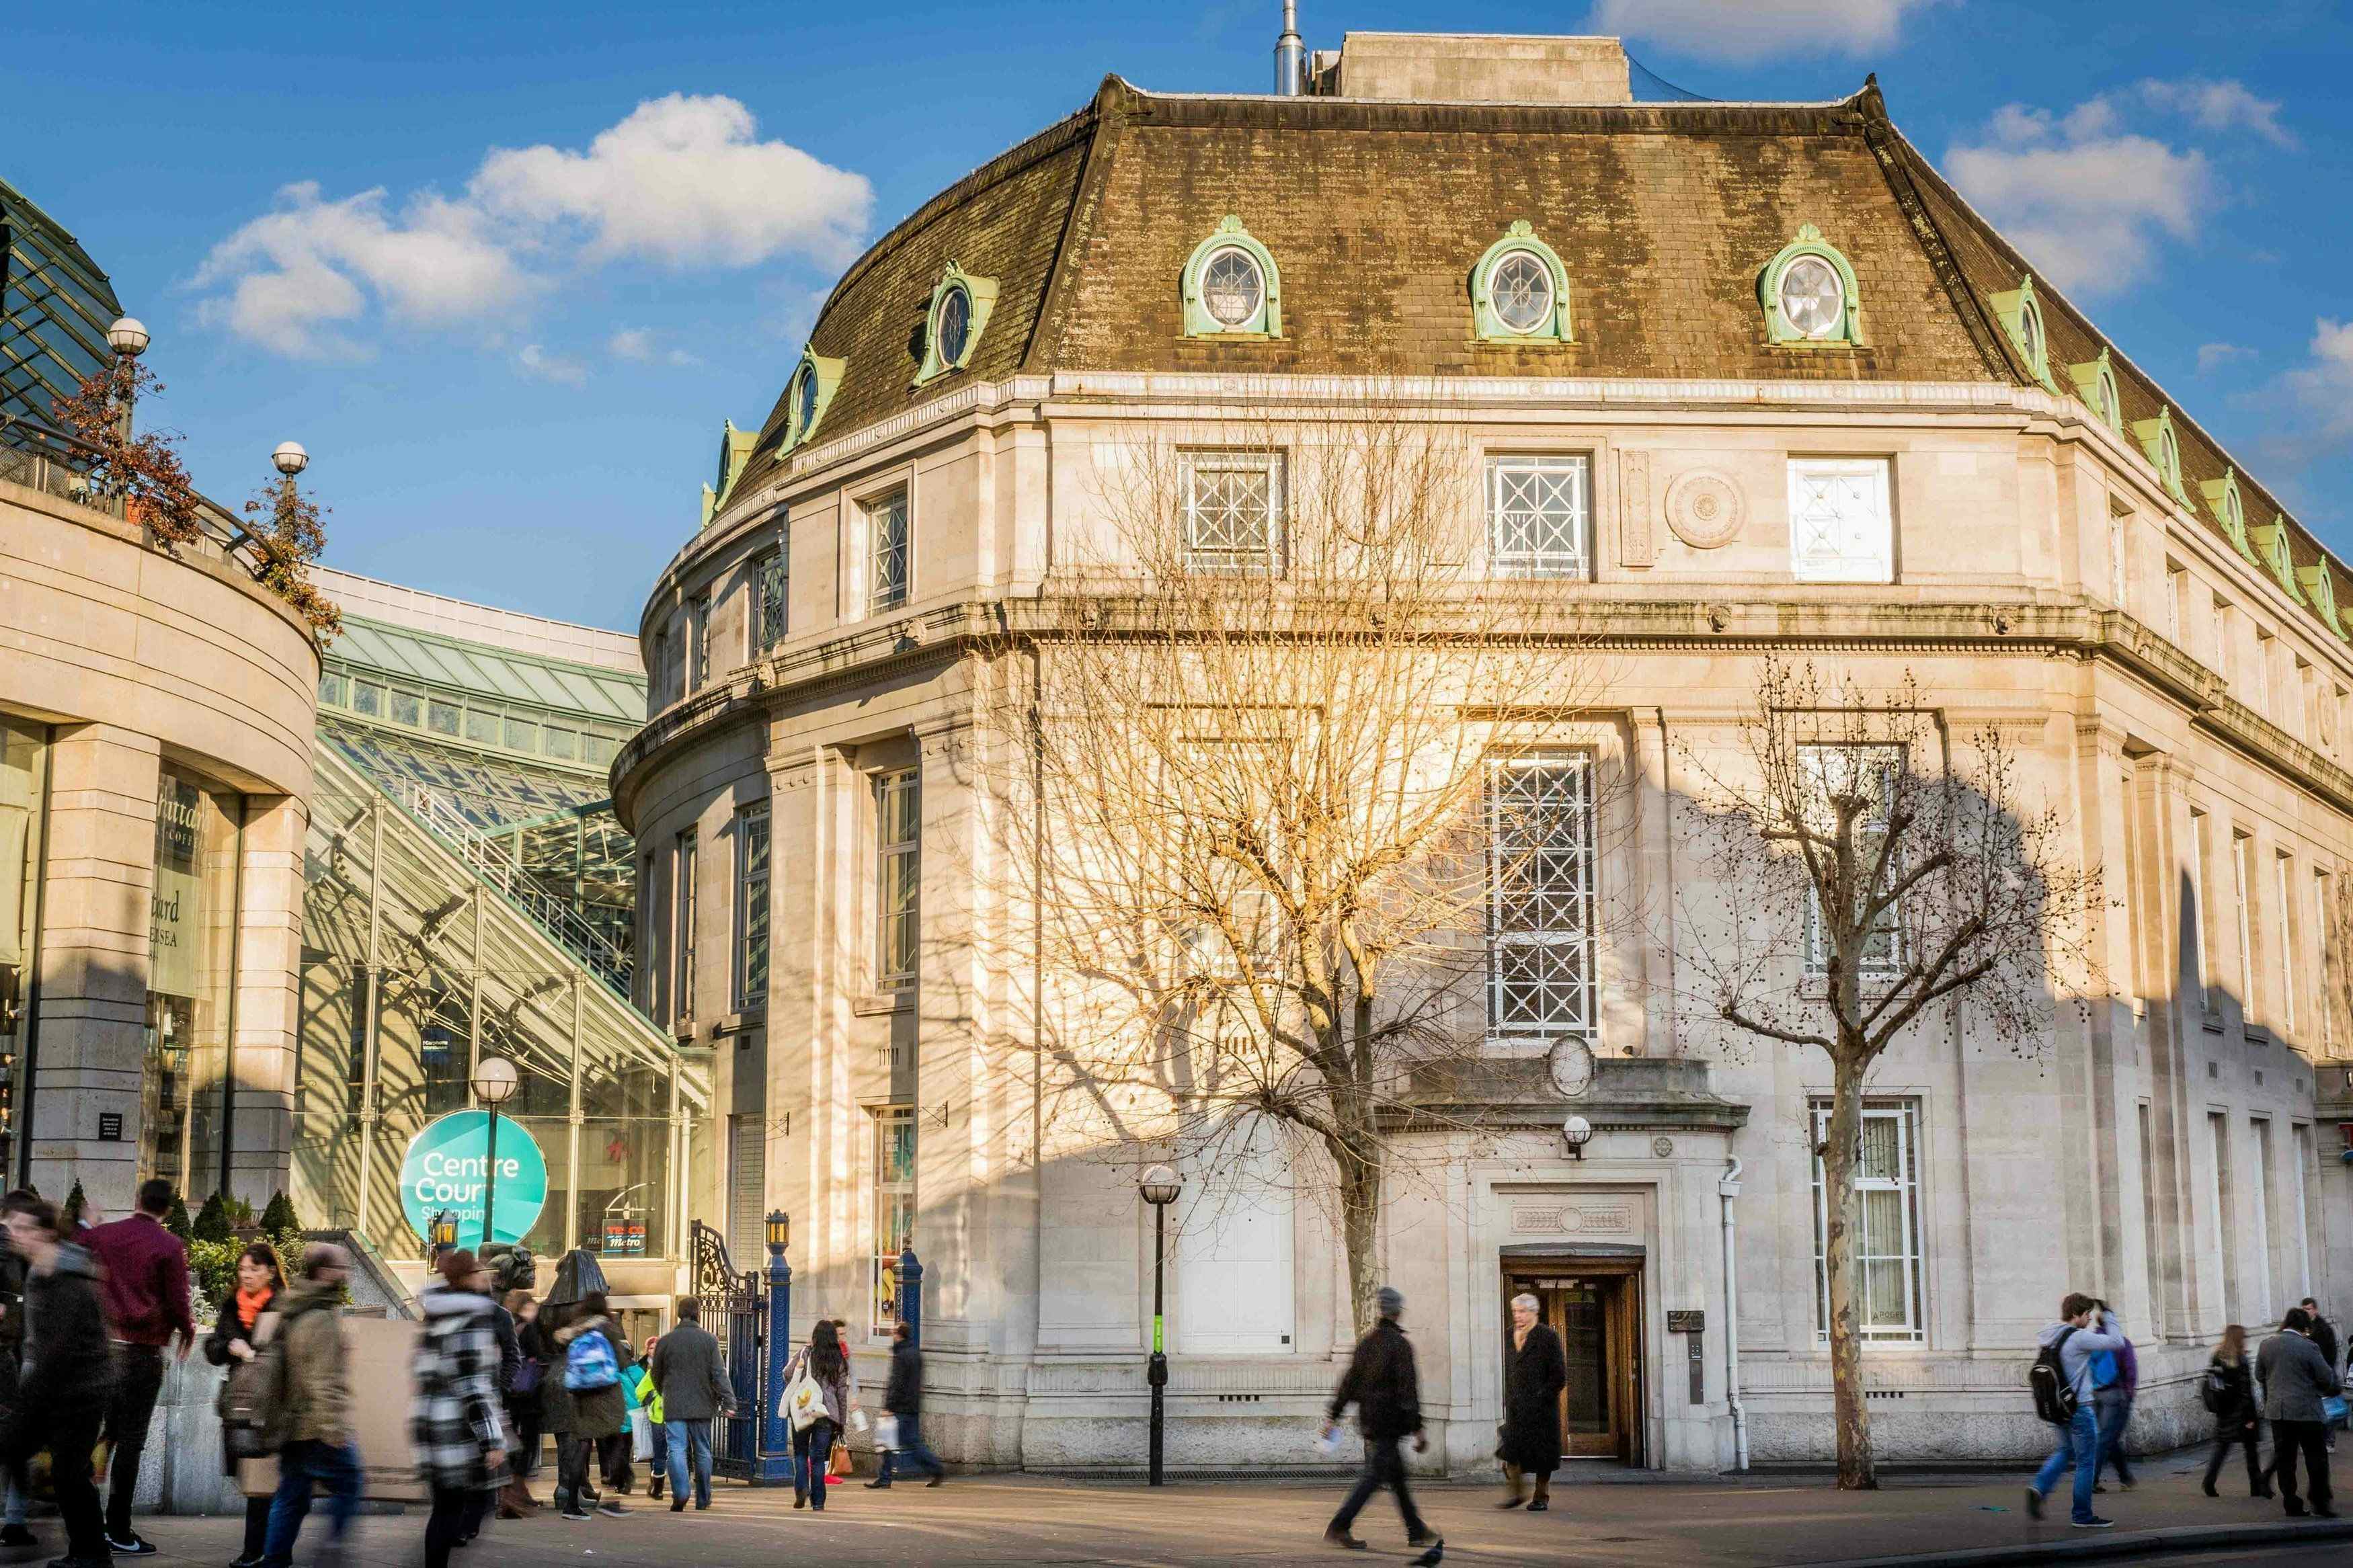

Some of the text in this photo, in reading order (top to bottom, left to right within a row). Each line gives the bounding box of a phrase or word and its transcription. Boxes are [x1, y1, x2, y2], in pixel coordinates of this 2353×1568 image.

[151, 891, 180, 923] tard
[150, 927, 177, 947] ELSEA
[424, 1152, 519, 1178] Centre
[610, 1237, 640, 1247] Metro
[1872, 1311, 1905, 1321] APOGEE
